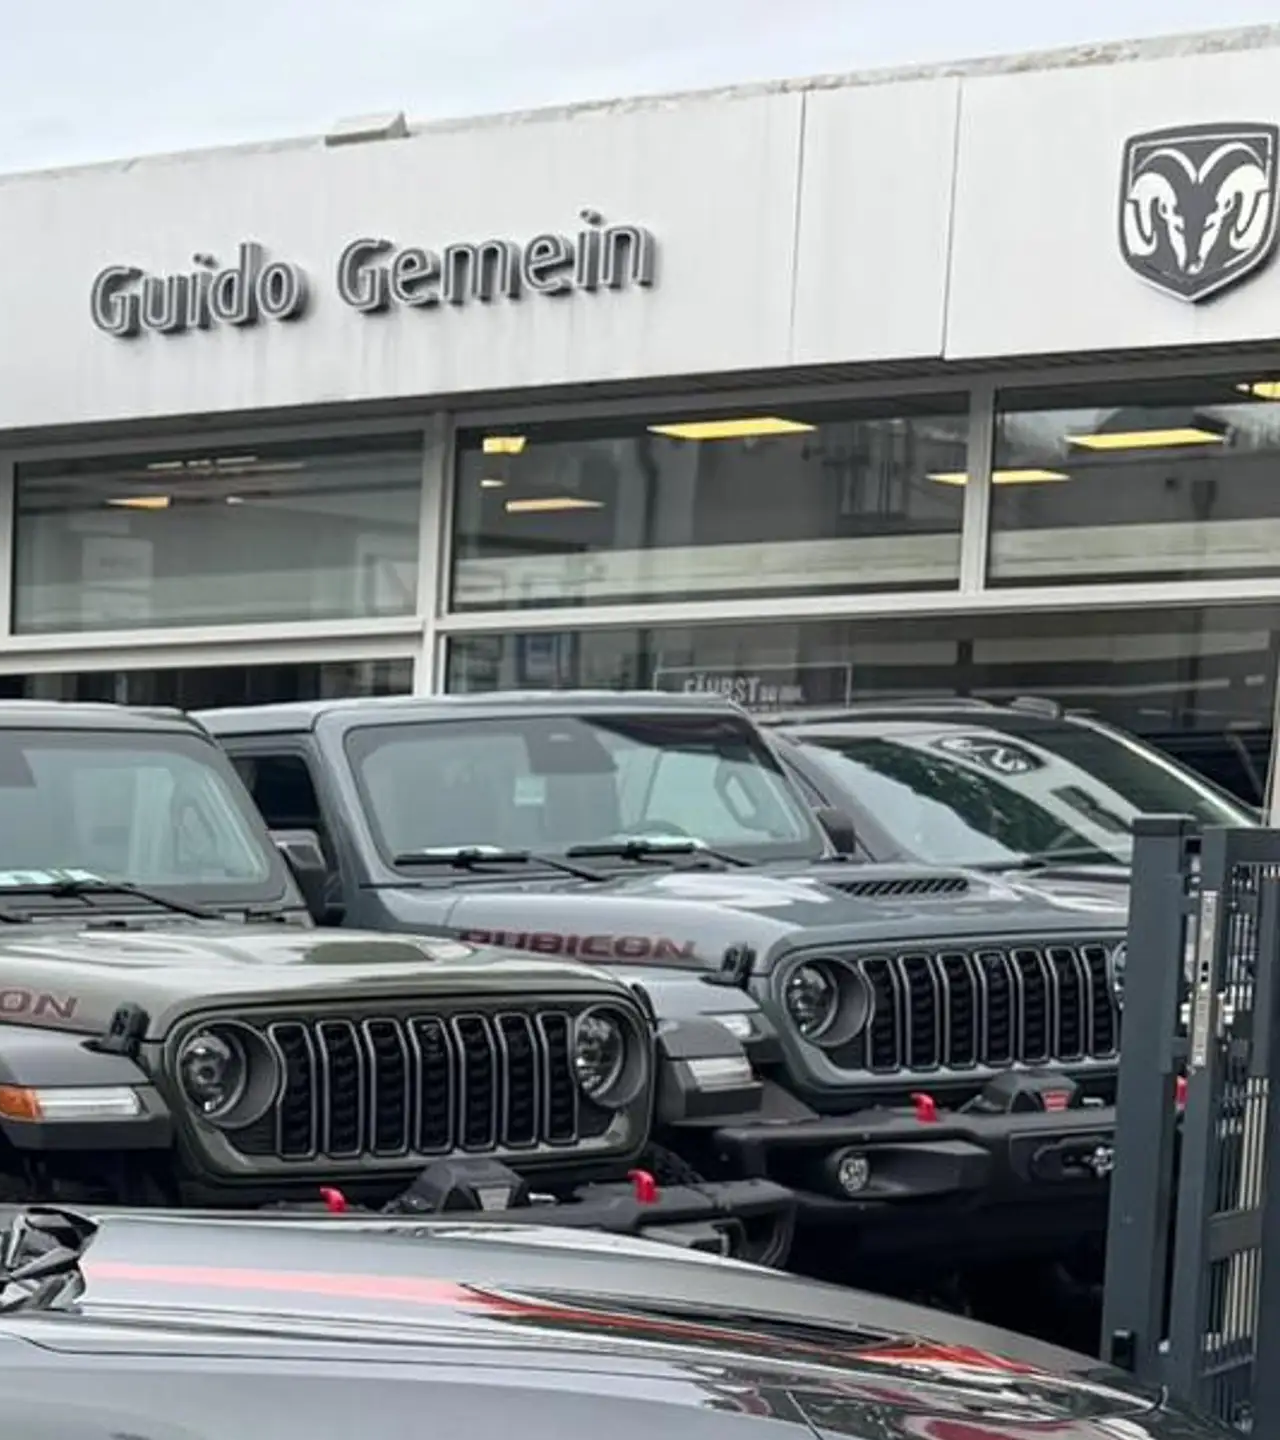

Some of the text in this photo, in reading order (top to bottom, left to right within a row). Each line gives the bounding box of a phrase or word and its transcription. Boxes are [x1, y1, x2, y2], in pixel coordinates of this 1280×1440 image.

[90, 208, 655, 336] Guido Gemein
[460, 928, 697, 959] RUBICON
